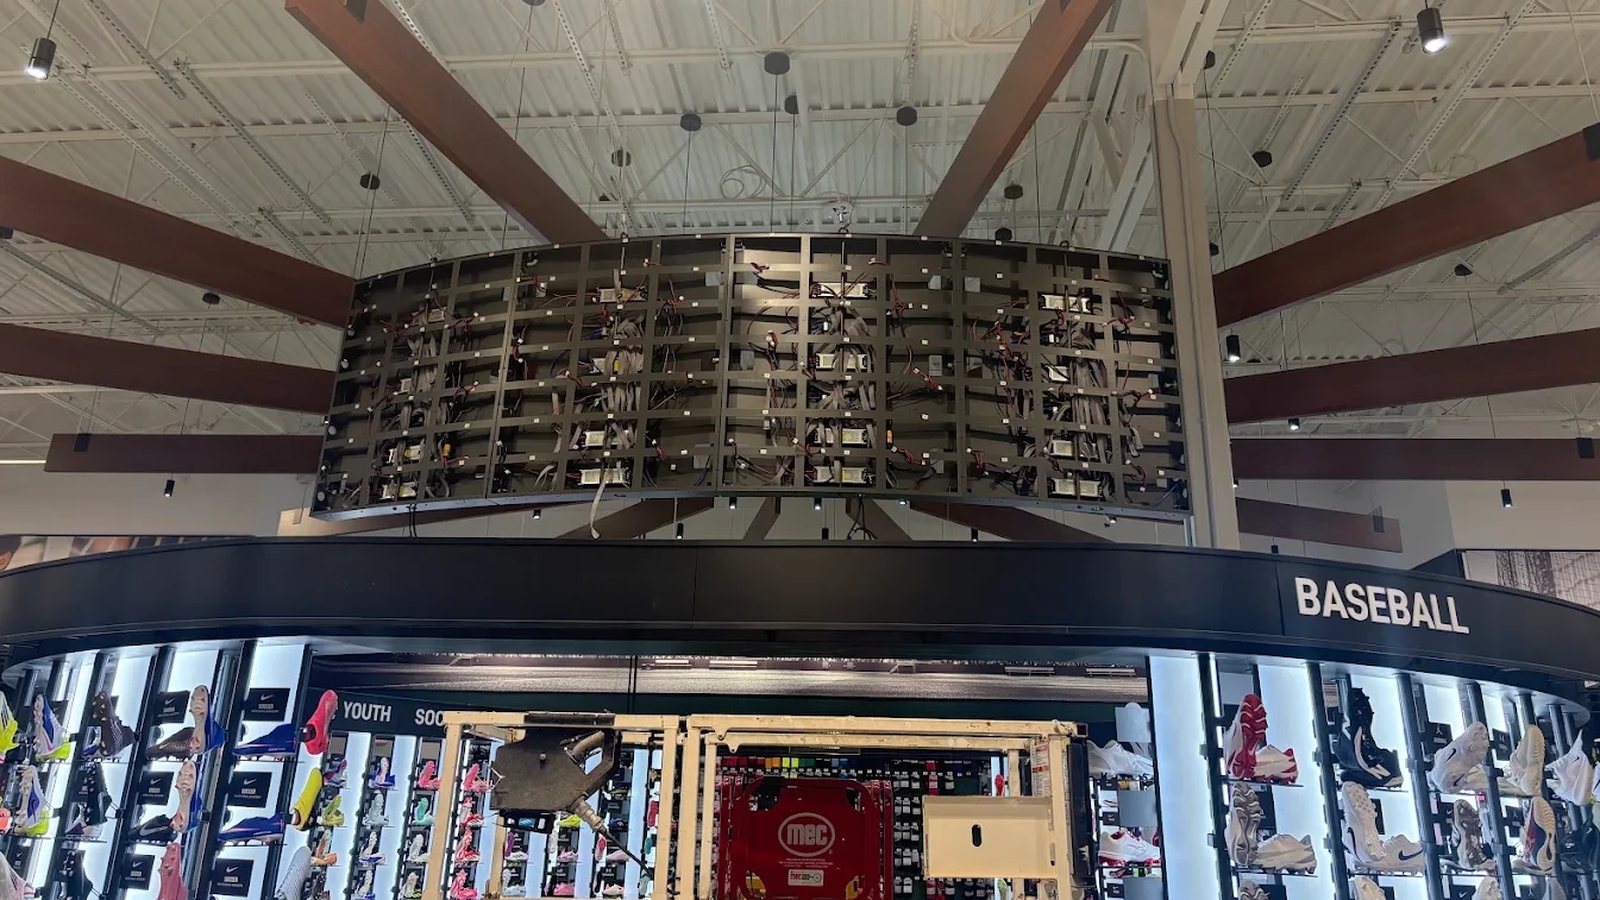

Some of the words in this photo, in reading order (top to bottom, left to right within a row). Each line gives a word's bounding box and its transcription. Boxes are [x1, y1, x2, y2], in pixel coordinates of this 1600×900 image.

[1295, 577, 1470, 634] BASEBALL
[343, 701, 392, 722] YOUTH
[414, 708, 444, 726] SOC
